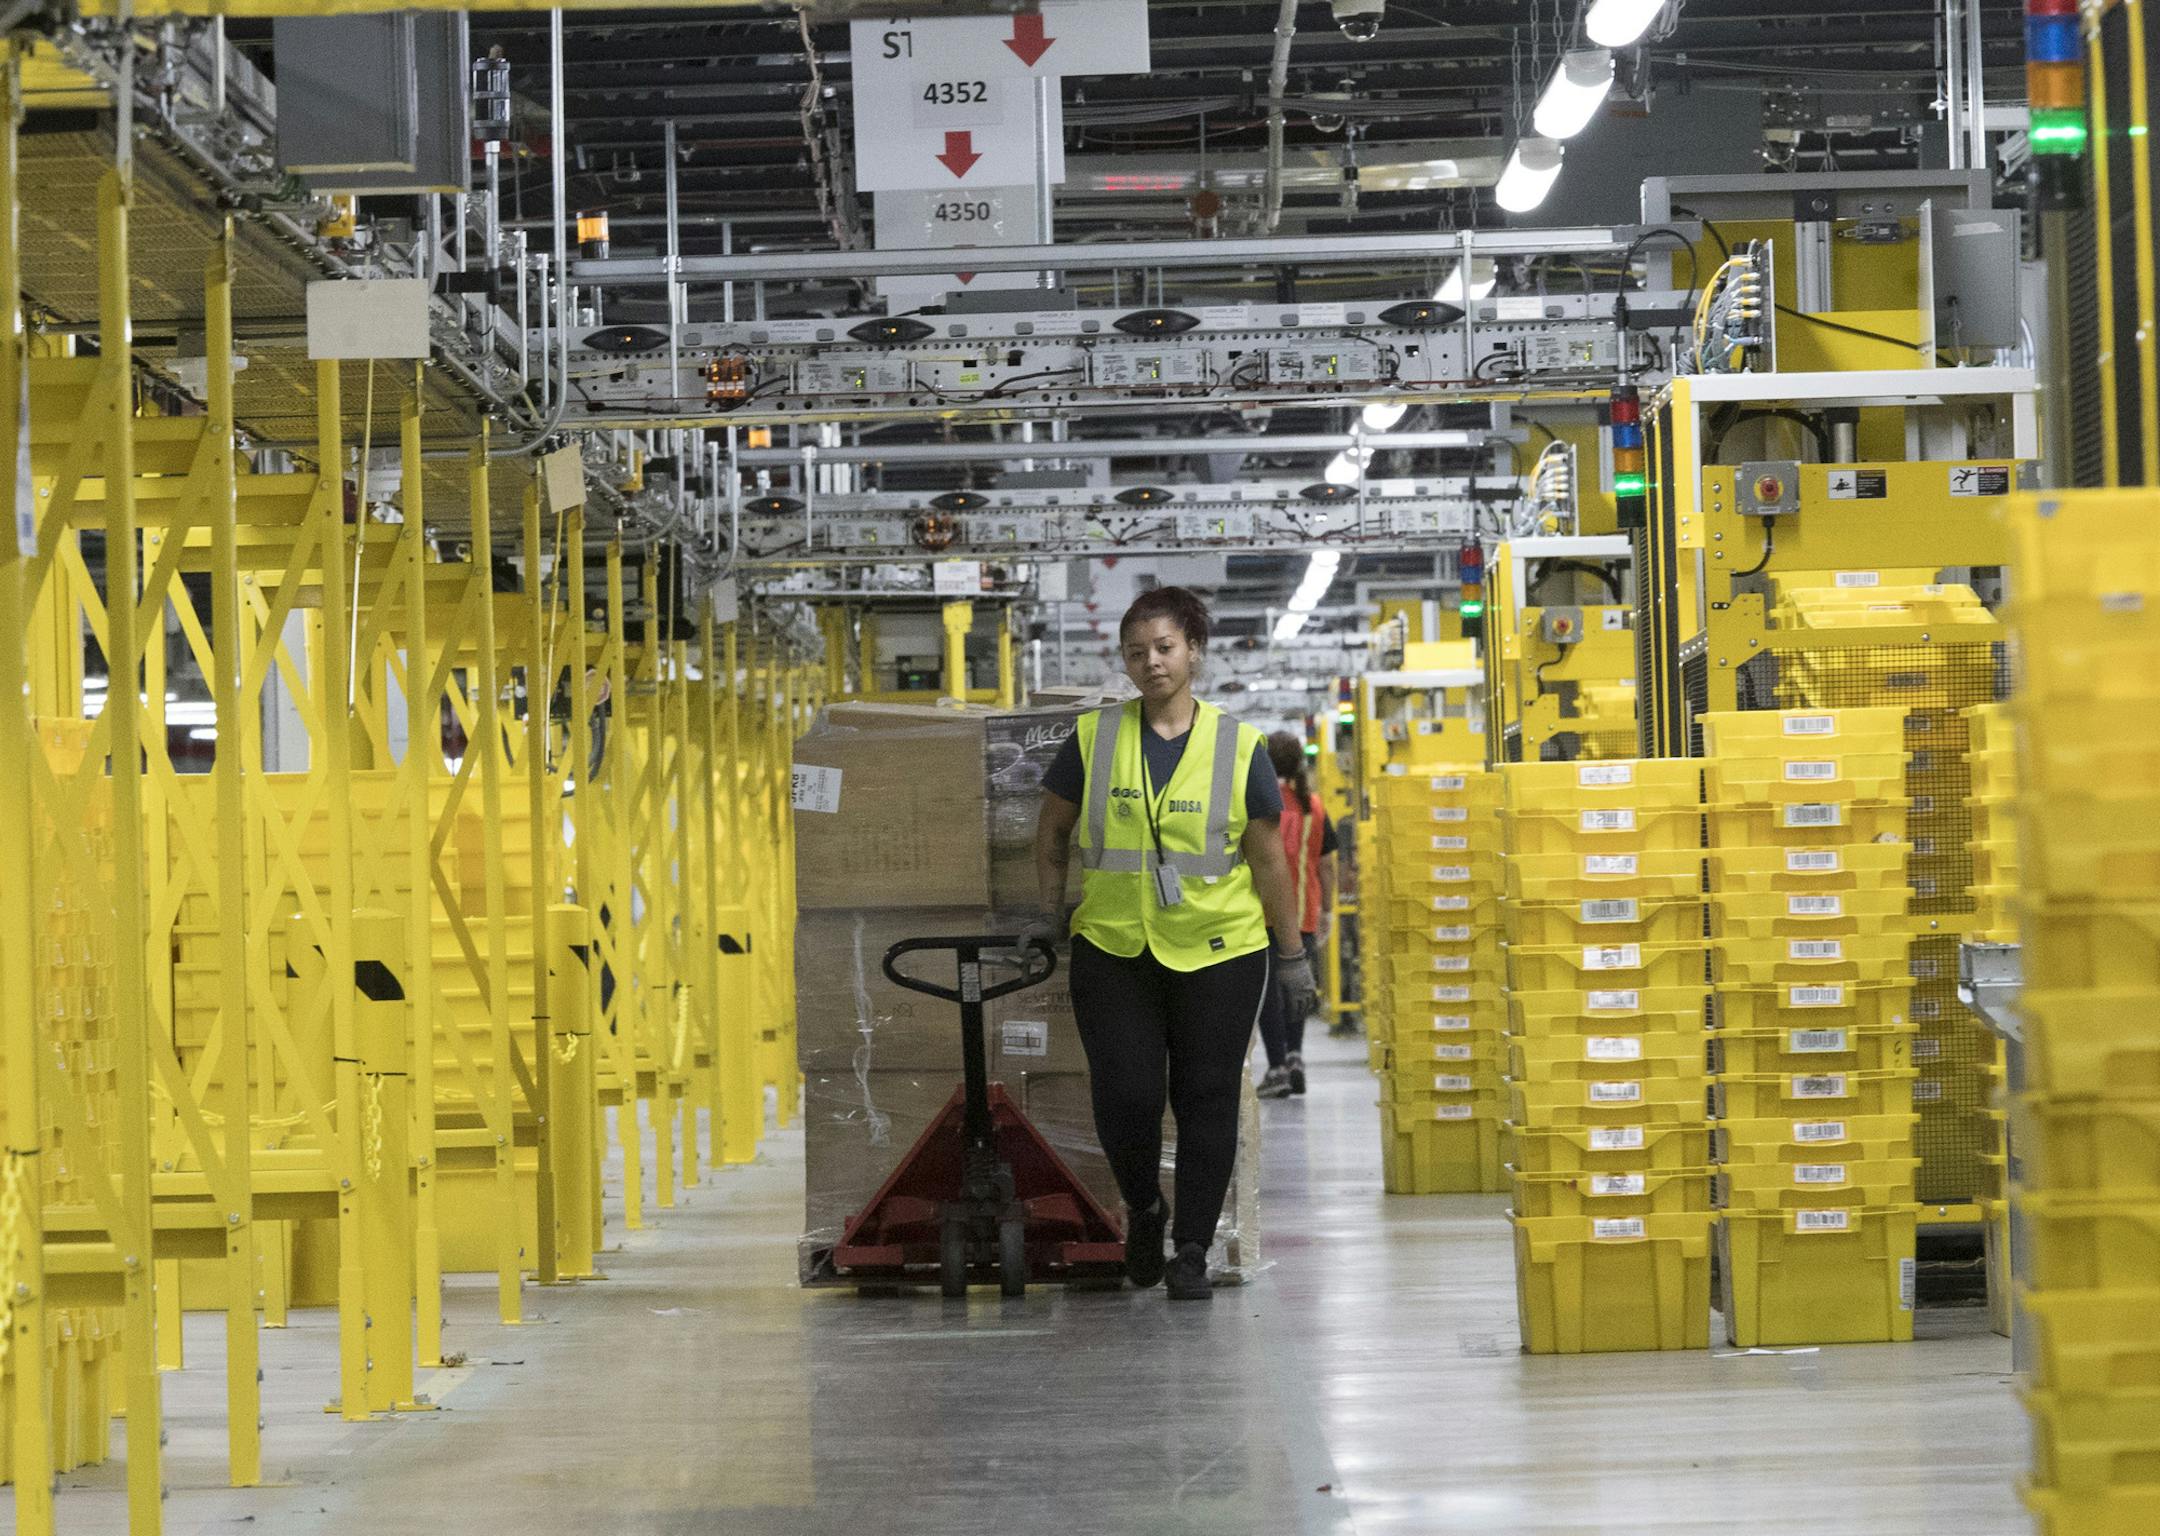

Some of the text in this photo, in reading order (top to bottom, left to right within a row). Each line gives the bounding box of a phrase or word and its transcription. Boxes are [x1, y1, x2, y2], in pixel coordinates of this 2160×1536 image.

[923, 80, 988, 105] 4352
[934, 201, 991, 222] 4350
[1168, 800, 1203, 814] DIOSA
